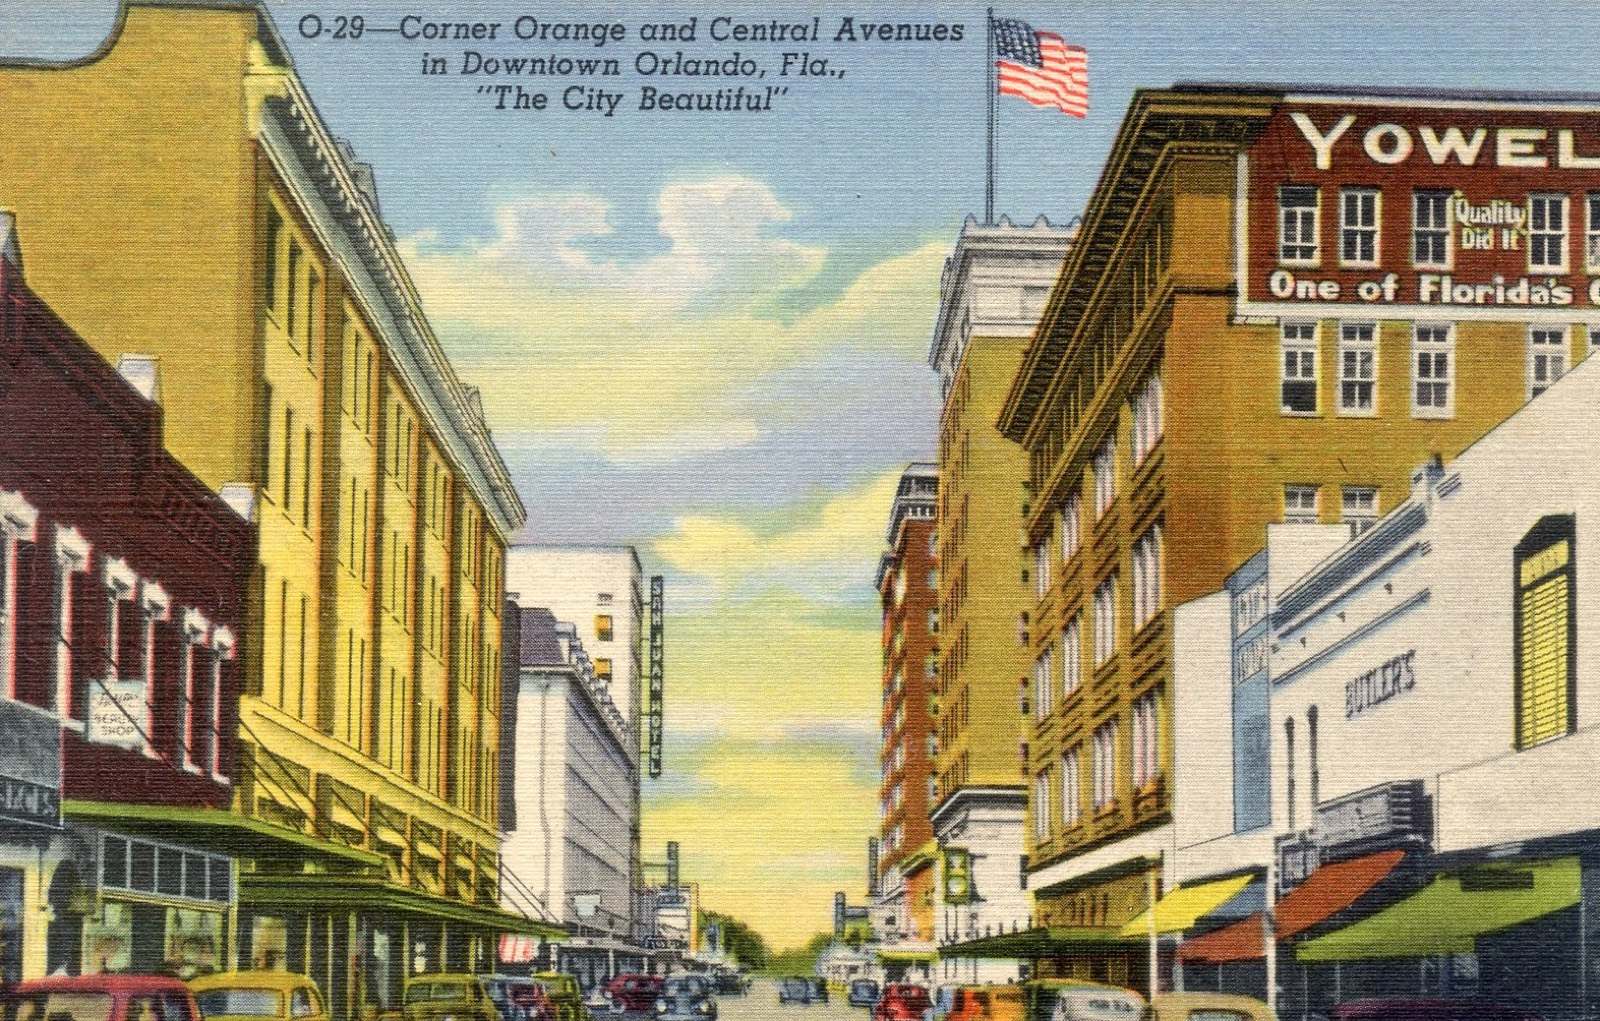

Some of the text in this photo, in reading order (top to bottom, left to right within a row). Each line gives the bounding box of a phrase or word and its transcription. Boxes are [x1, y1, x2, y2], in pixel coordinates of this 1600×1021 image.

[1290, 112, 1600, 170] YOWEL
[1269, 270, 1341, 300] One
[1358, 272, 1399, 302] of
[1419, 274, 1574, 305] Florida's
